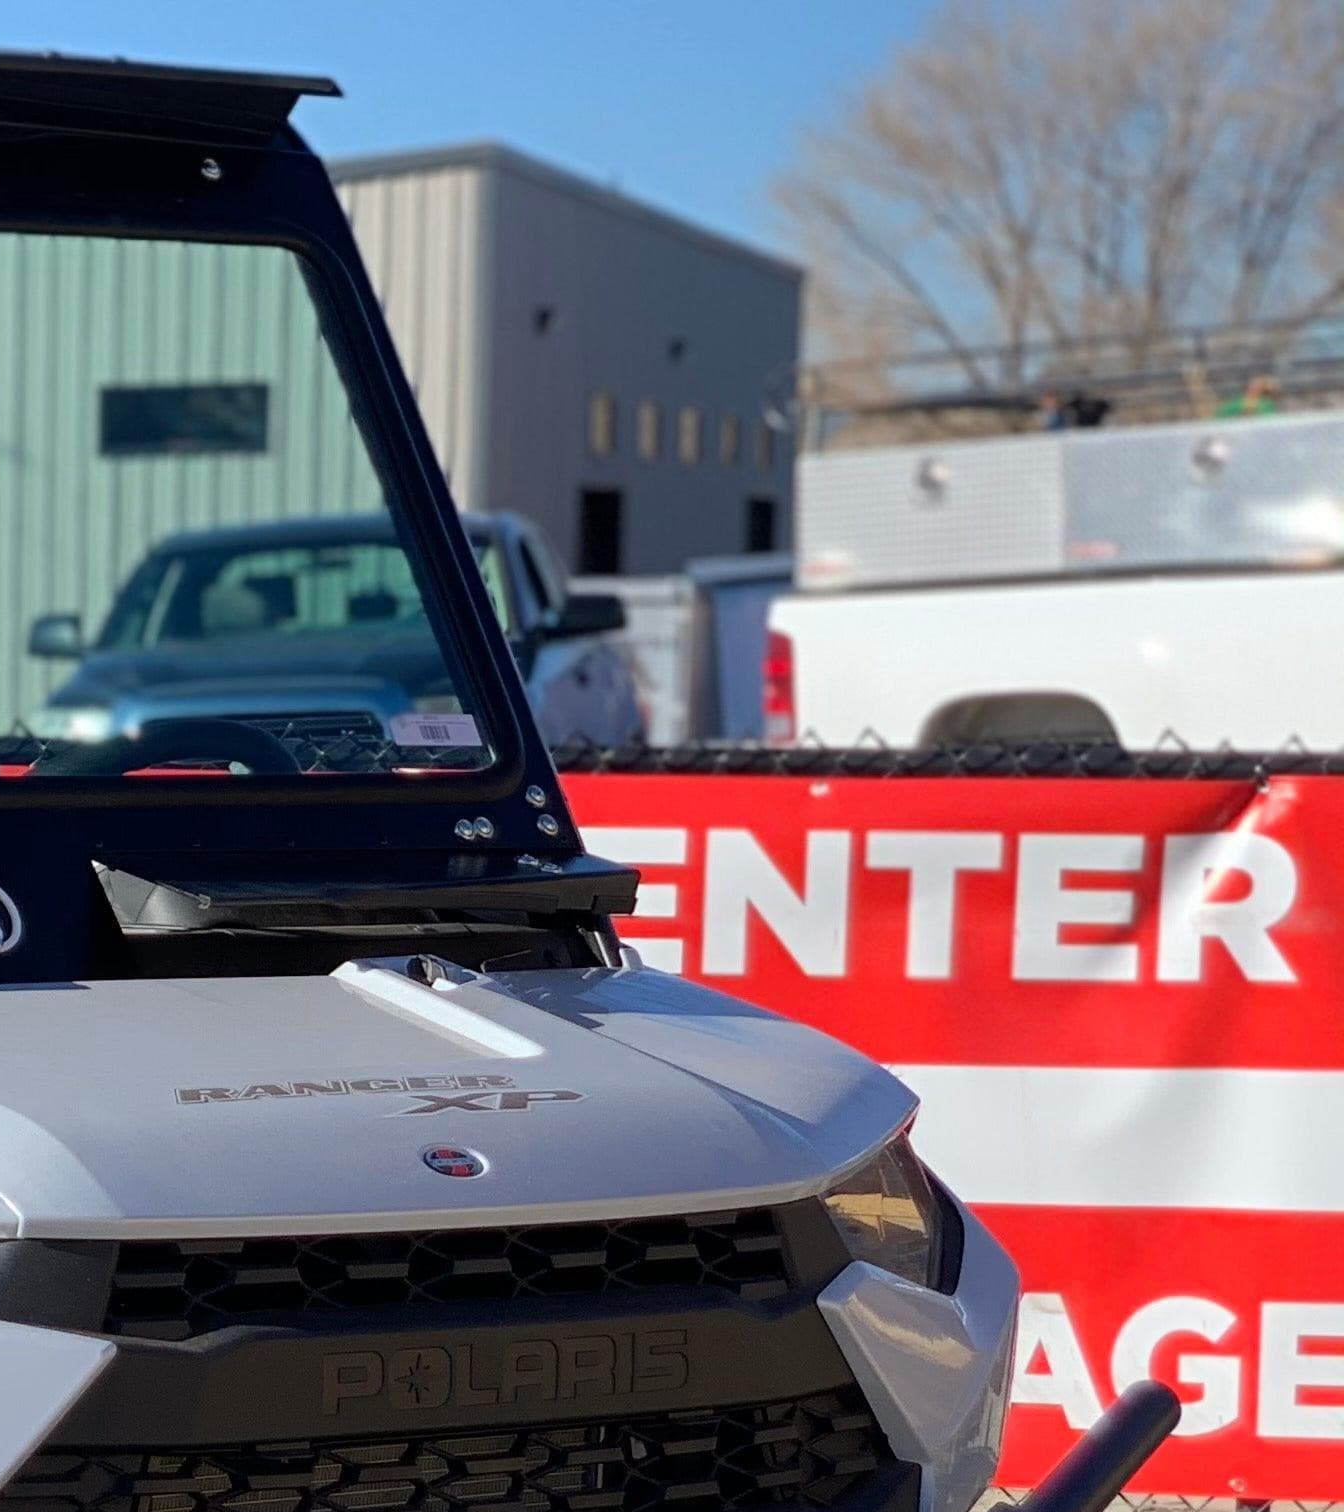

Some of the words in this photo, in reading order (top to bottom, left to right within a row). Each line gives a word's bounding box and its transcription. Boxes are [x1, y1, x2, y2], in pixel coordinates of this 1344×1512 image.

[175, 1074, 516, 1104] RANGER
[380, 1088, 590, 1118] XP
[322, 1328, 689, 1417] POLARIS
